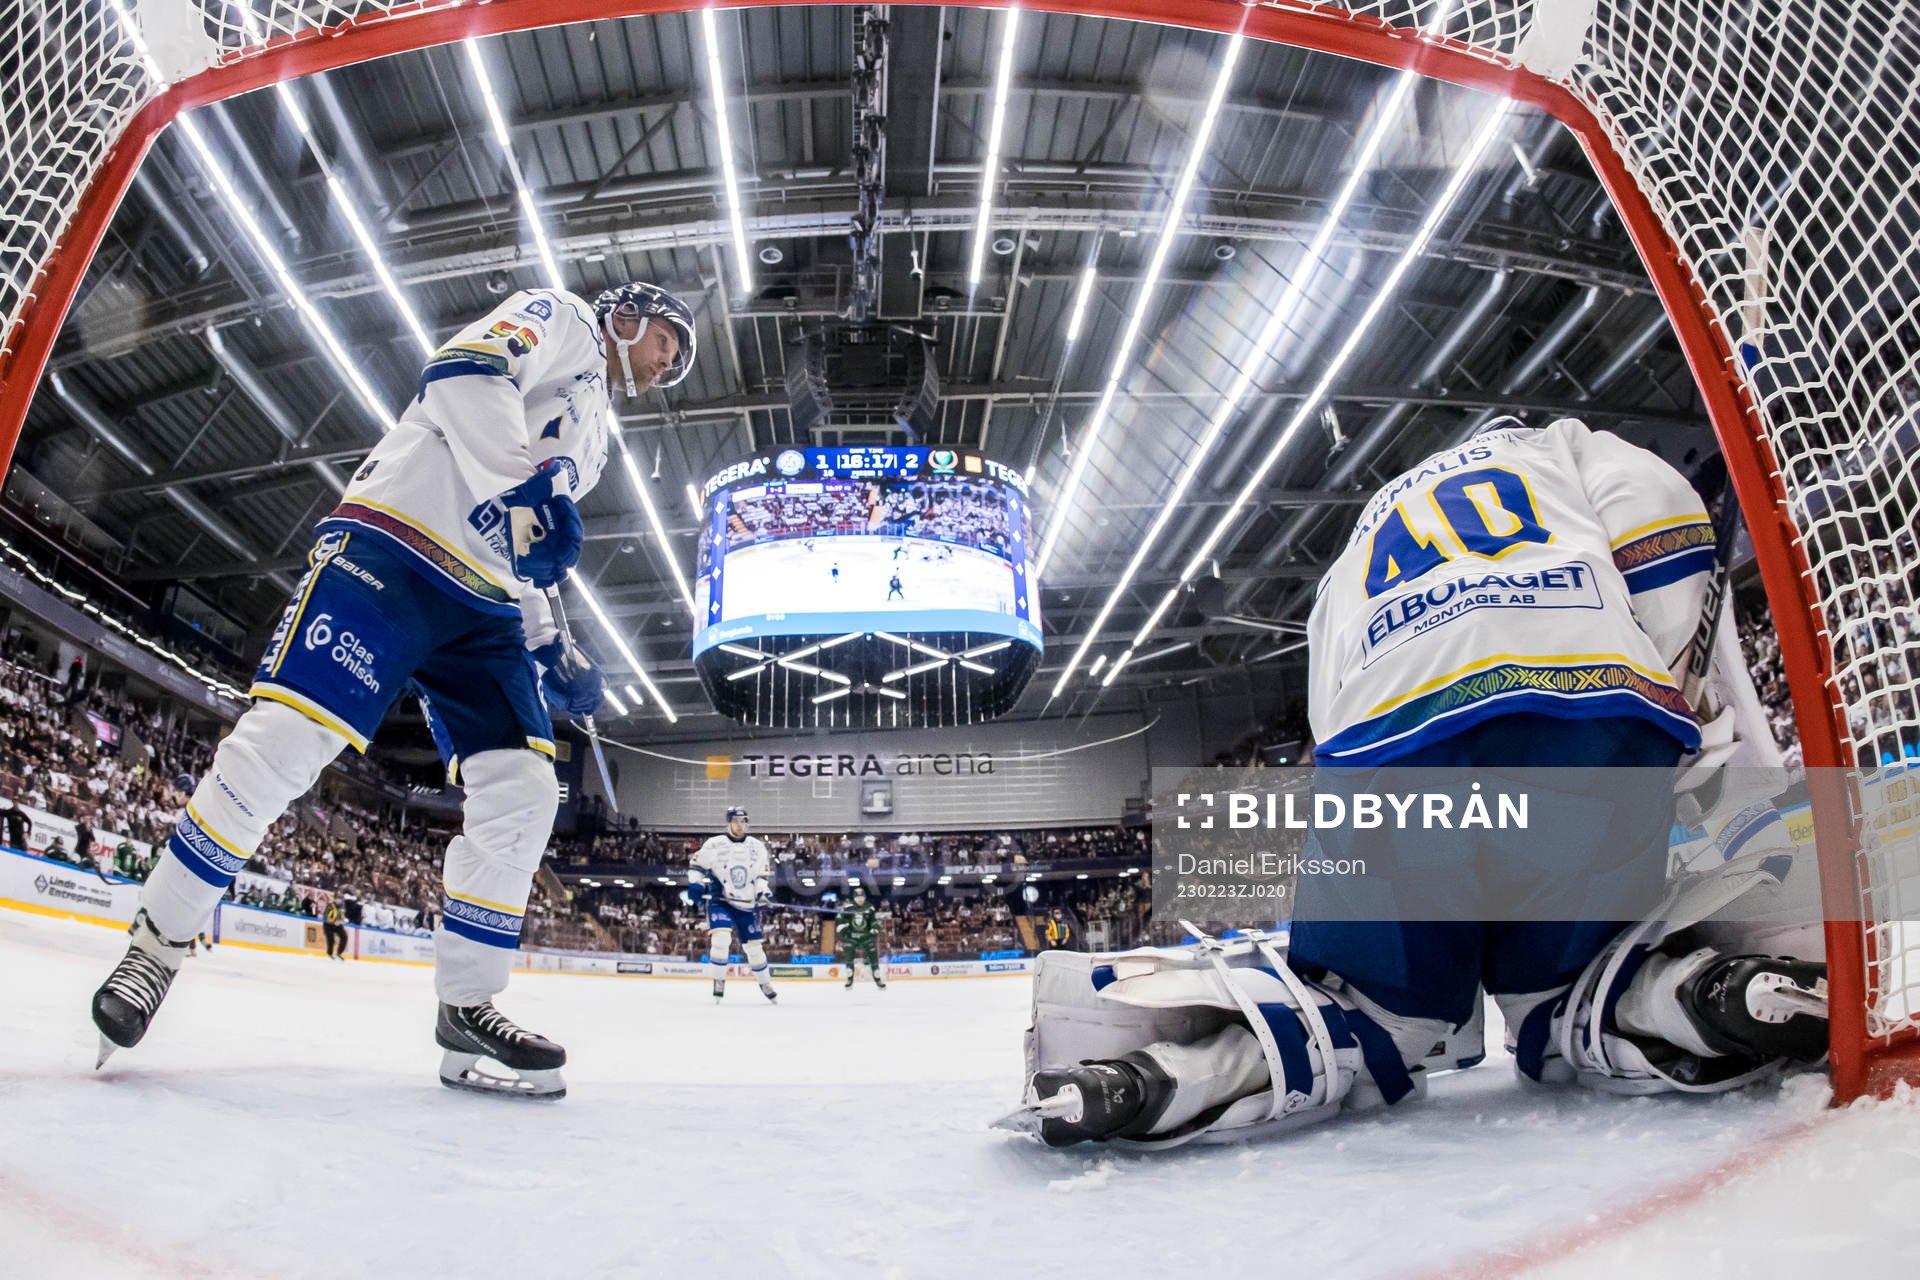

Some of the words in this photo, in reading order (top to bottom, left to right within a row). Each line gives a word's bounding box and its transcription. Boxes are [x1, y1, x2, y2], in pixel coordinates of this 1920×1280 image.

[816, 454, 829, 469] 1
[905, 454, 919, 468] 2
[1355, 446, 1493, 546] ARMALIS
[1362, 464, 1556, 600] 40
[331, 555, 385, 591] BAUER
[1367, 565, 1585, 650] ELBOLAGET
[1413, 594, 1501, 634] MONTAGE
[1508, 594, 1536, 605] AB
[339, 631, 375, 665] Clas
[331, 645, 381, 694] Ohlson
[742, 754, 884, 777] TEGERA
[895, 751, 996, 776] arena
[48, 875, 77, 890] Linde
[464, 1029, 498, 1055] BAUER
